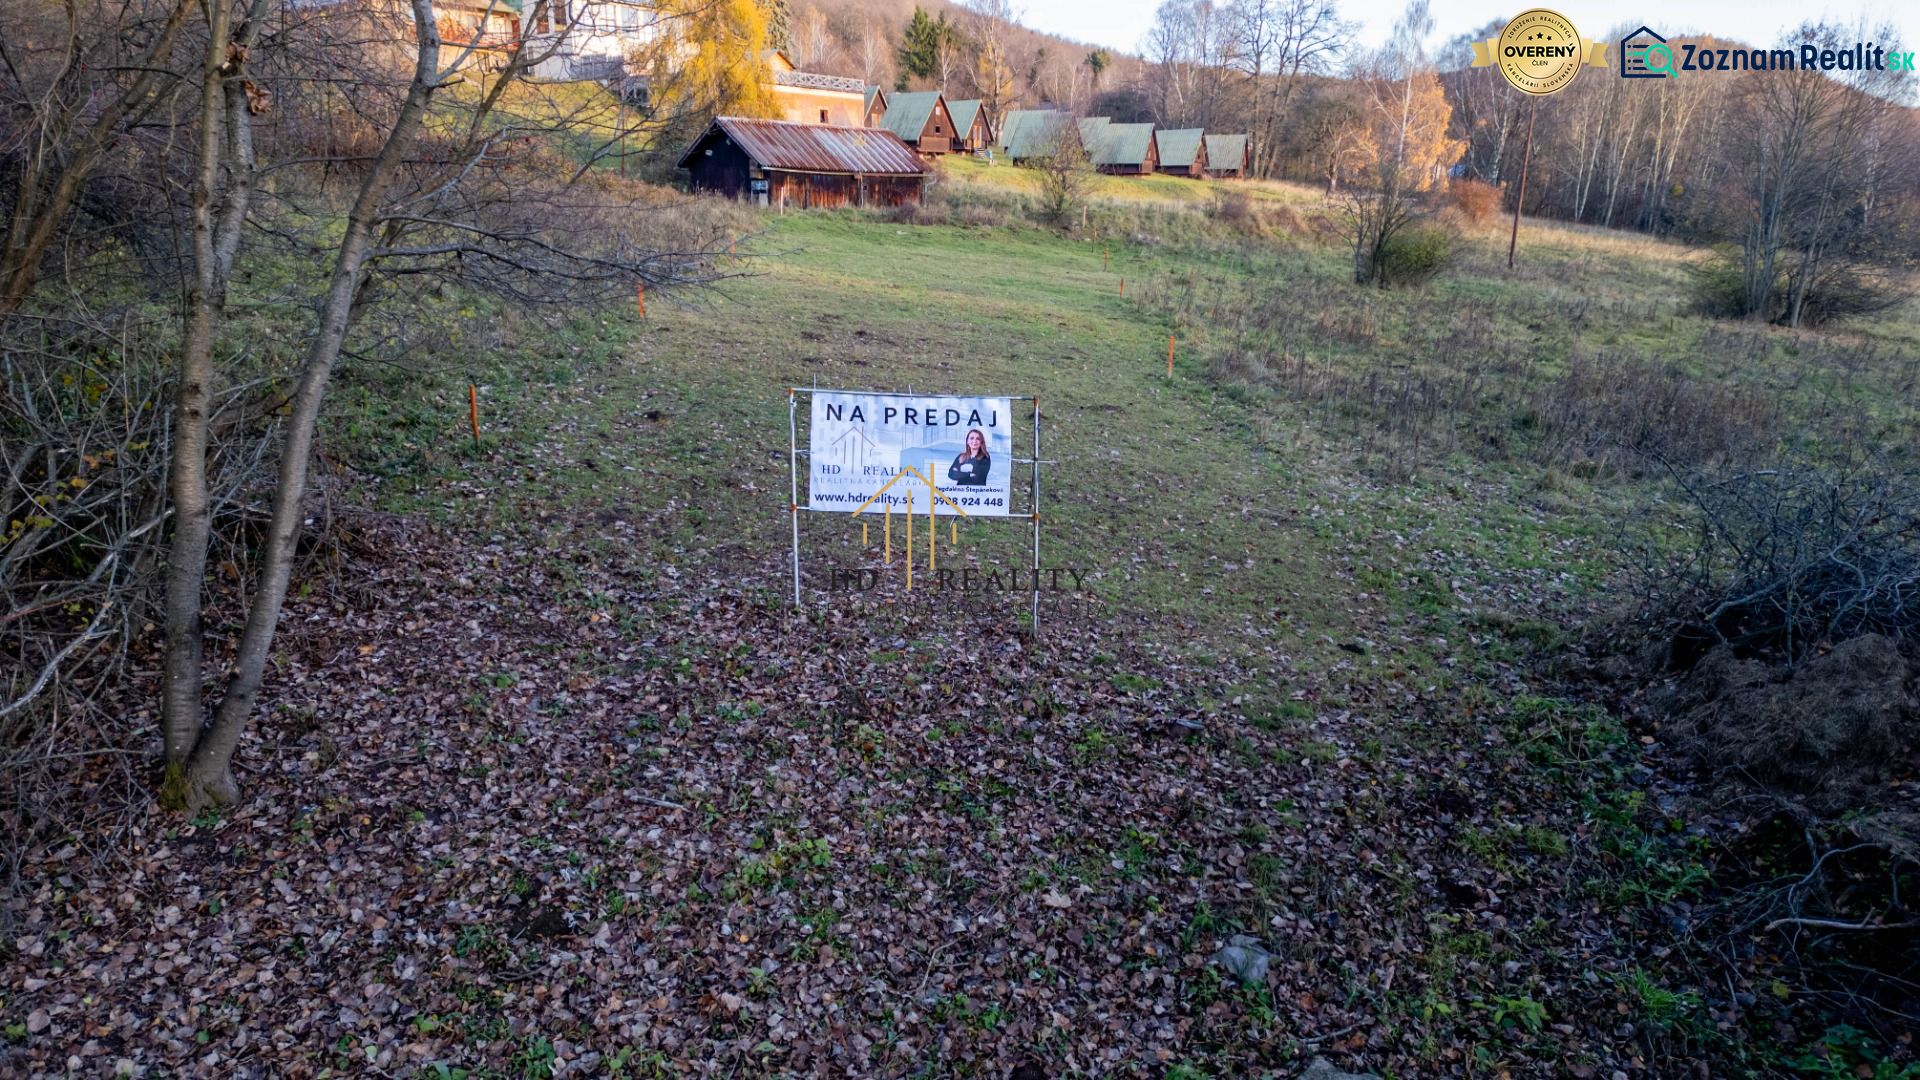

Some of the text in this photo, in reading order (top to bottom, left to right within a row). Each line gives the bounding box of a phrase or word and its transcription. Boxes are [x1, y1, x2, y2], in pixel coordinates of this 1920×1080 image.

[826, 403, 997, 428] NA PREDAJ
[822, 464, 841, 475] HD
[815, 492, 915, 507] www.hdreality.sk
[961, 497, 981, 506] 924
[983, 497, 1004, 507] 448
